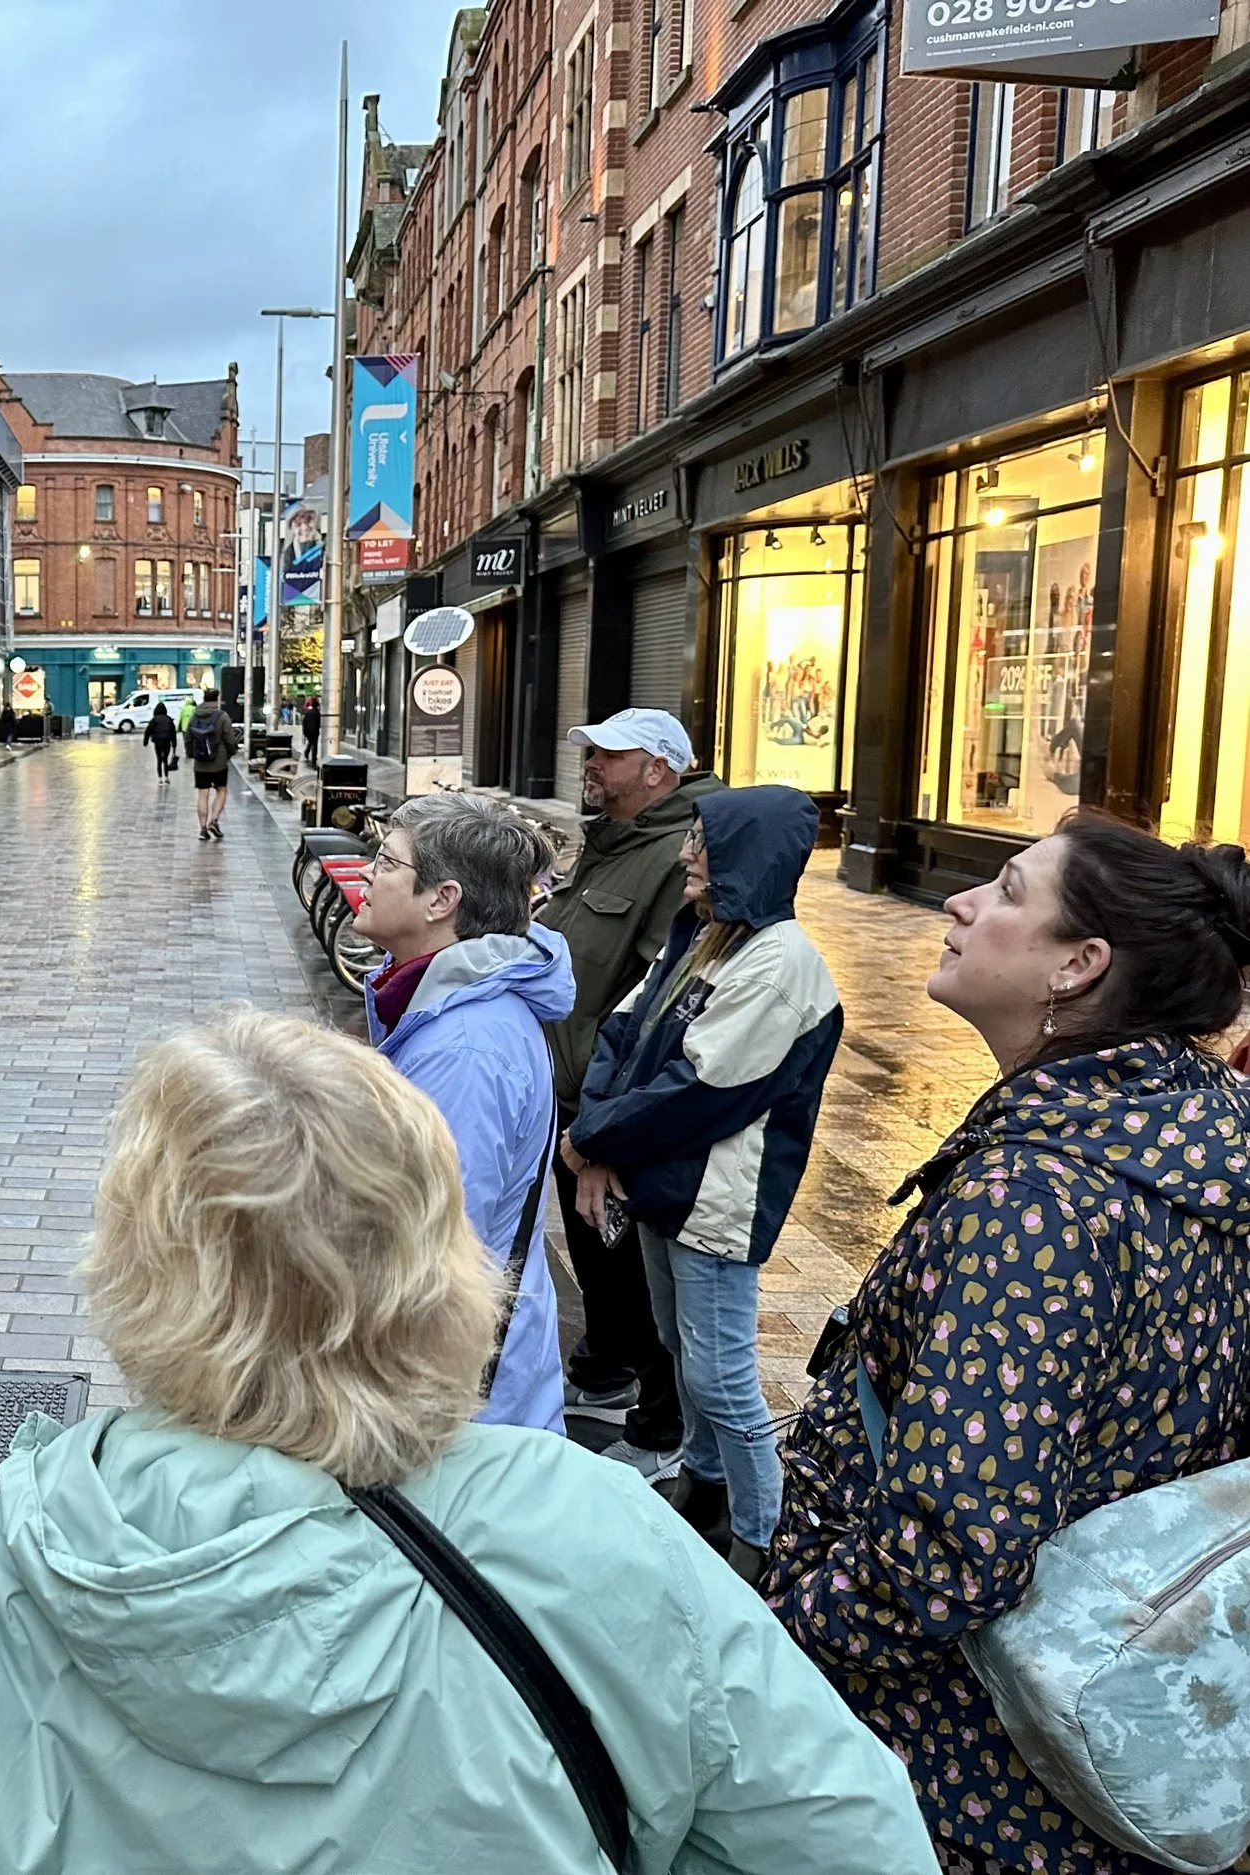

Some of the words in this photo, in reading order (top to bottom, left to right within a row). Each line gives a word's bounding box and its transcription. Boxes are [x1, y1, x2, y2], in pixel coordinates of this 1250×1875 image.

[927, 0, 993, 27] 028
[926, 18, 1074, 45] cushmanwakefield-ni.com
[365, 432, 379, 488] University
[378, 432, 389, 466] Ulster
[763, 440, 808, 481] WILLS
[613, 504, 633, 527] MINT
[634, 489, 666, 518] VELVET
[364, 540, 377, 548] TO
